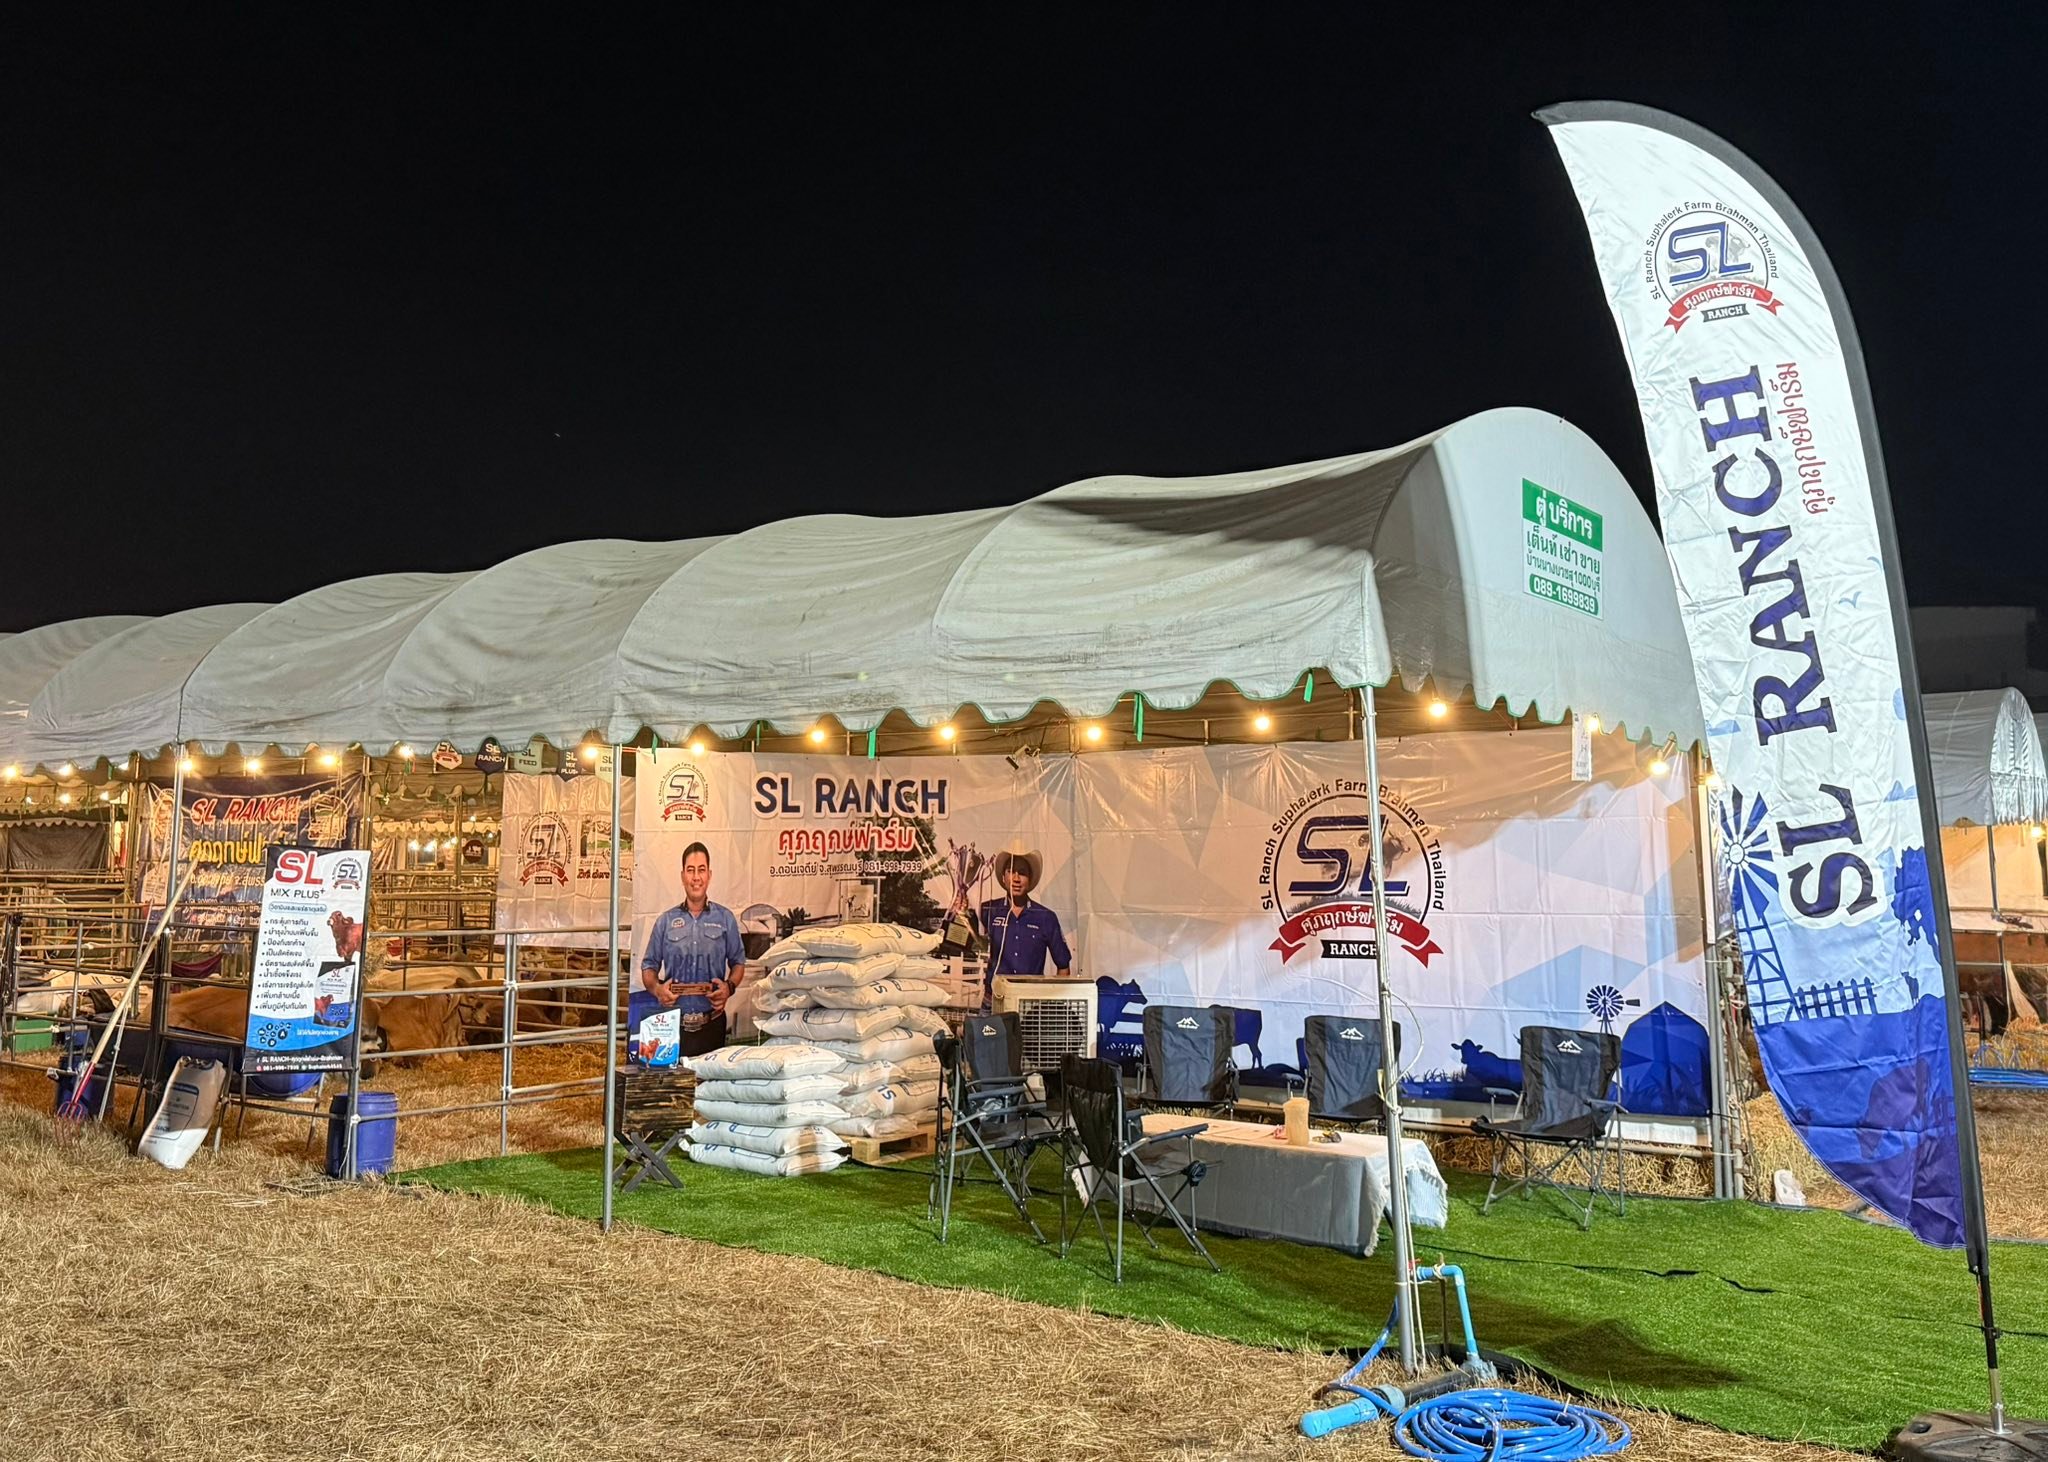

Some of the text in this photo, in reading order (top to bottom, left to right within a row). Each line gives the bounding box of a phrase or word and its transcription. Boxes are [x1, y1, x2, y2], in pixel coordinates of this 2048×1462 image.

[1684, 201, 1711, 211] Farm
[1715, 202, 1759, 234] Brahman
[1646, 206, 1683, 247] Suphalerk
[1644, 250, 1655, 283] Ranch
[1668, 221, 1754, 286] SL
[1759, 234, 1779, 279] Thailand
[1707, 306, 1744, 320] RANCH
[1768, 362, 1836, 516] ศุภฤกษ์ฟาร์ม
[1548, 498, 1593, 540] บริการ
[1560, 541, 1578, 566] เช่า
[1580, 553, 1601, 575] ขาย
[1533, 577, 1596, 613] 089-1699839
[1689, 365, 1878, 918] SL RANCH
[478, 755, 505, 763] RANCH
[486, 743, 501, 753] SL
[521, 748, 536, 757] SL
[565, 751, 578, 761] SL
[667, 775, 699, 799] SL
[755, 777, 948, 814] SL RANCH
[190, 798, 218, 825] SL
[223, 796, 301, 825] RANCH
[1272, 783, 1331, 835] Suphalerk
[779, 820, 917, 860] ศุภฤกษ์ฟาร์ม
[1288, 814, 1411, 897] SL
[275, 850, 324, 885] SL
[770, 861, 816, 875] อ.ดอนเจดีย์
[1259, 838, 1277, 885] Ranch
[1427, 839, 1446, 911] Thailand
[270, 888, 291, 897] MIX
[1260, 889, 1273, 910] SL
